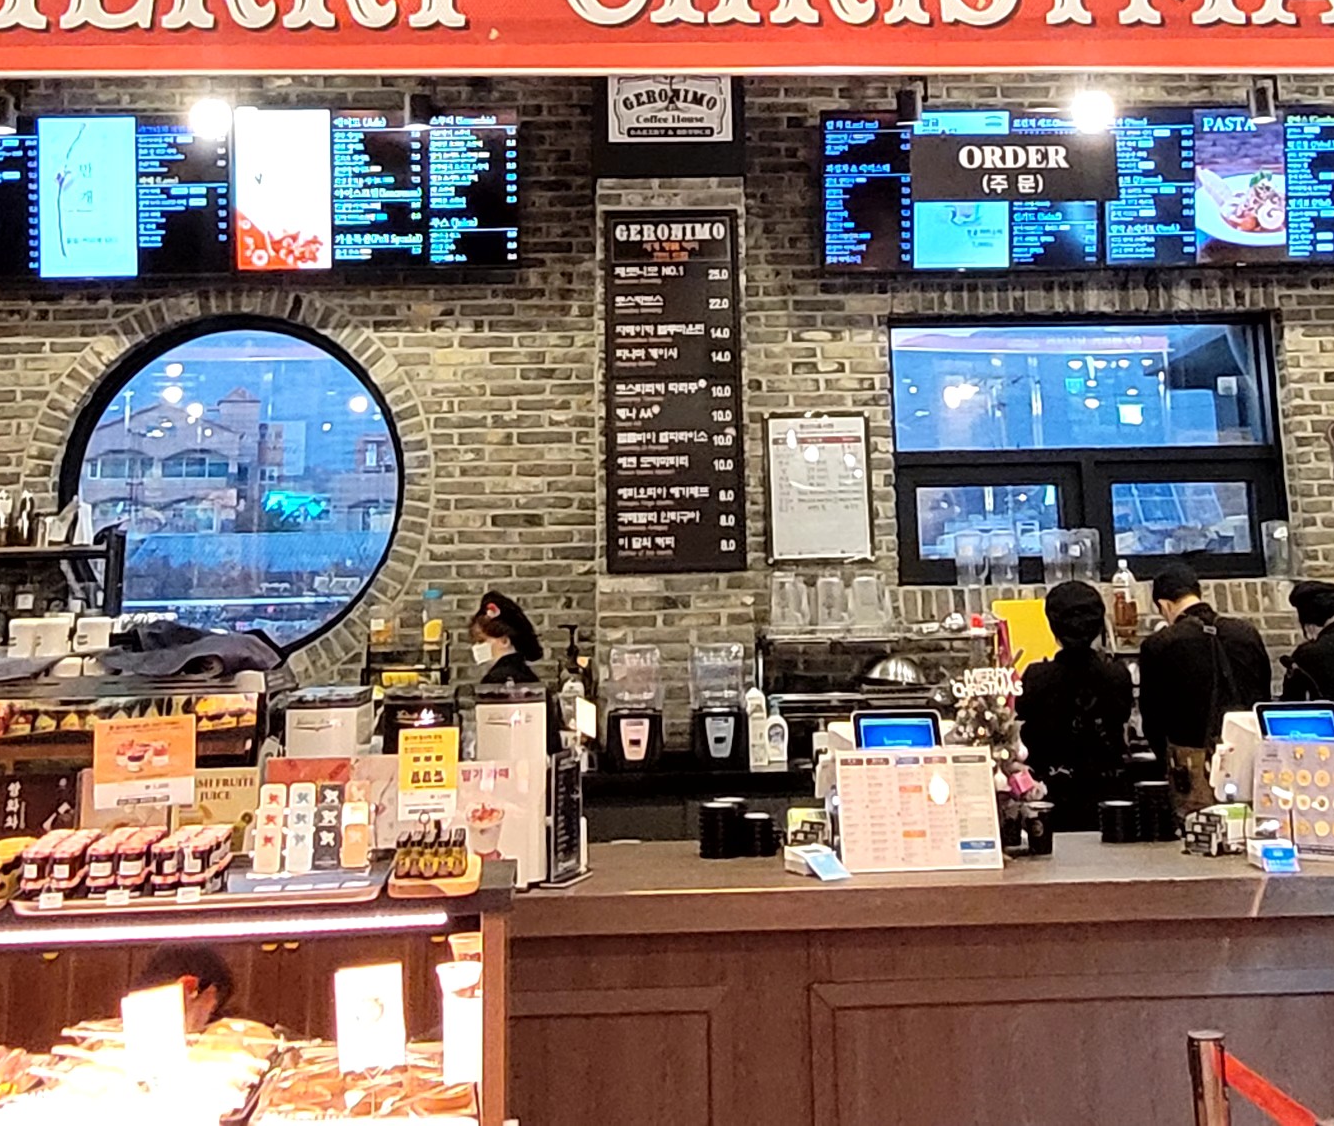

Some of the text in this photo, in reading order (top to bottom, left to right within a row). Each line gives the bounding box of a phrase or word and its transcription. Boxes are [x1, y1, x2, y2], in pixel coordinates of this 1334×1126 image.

[622, 87, 718, 112] GERONIMO
[635, 114, 705, 124] Coffee House
[1202, 116, 1257, 132] PASTA
[958, 144, 1069, 170] ORDER
[614, 222, 726, 242] GERONIMO
[710, 327, 731, 339] 14.0
[710, 350, 732, 363] 14.0
[710, 385, 732, 398] 10.0
[710, 409, 733, 422] 10.0
[712, 434, 734, 446] 10.0
[713, 458, 734, 472] 10.0
[963, 666, 1016, 684] MERRY
[950, 679, 1024, 698] CHRISTMAS
[199, 790, 232, 803] JUICE
